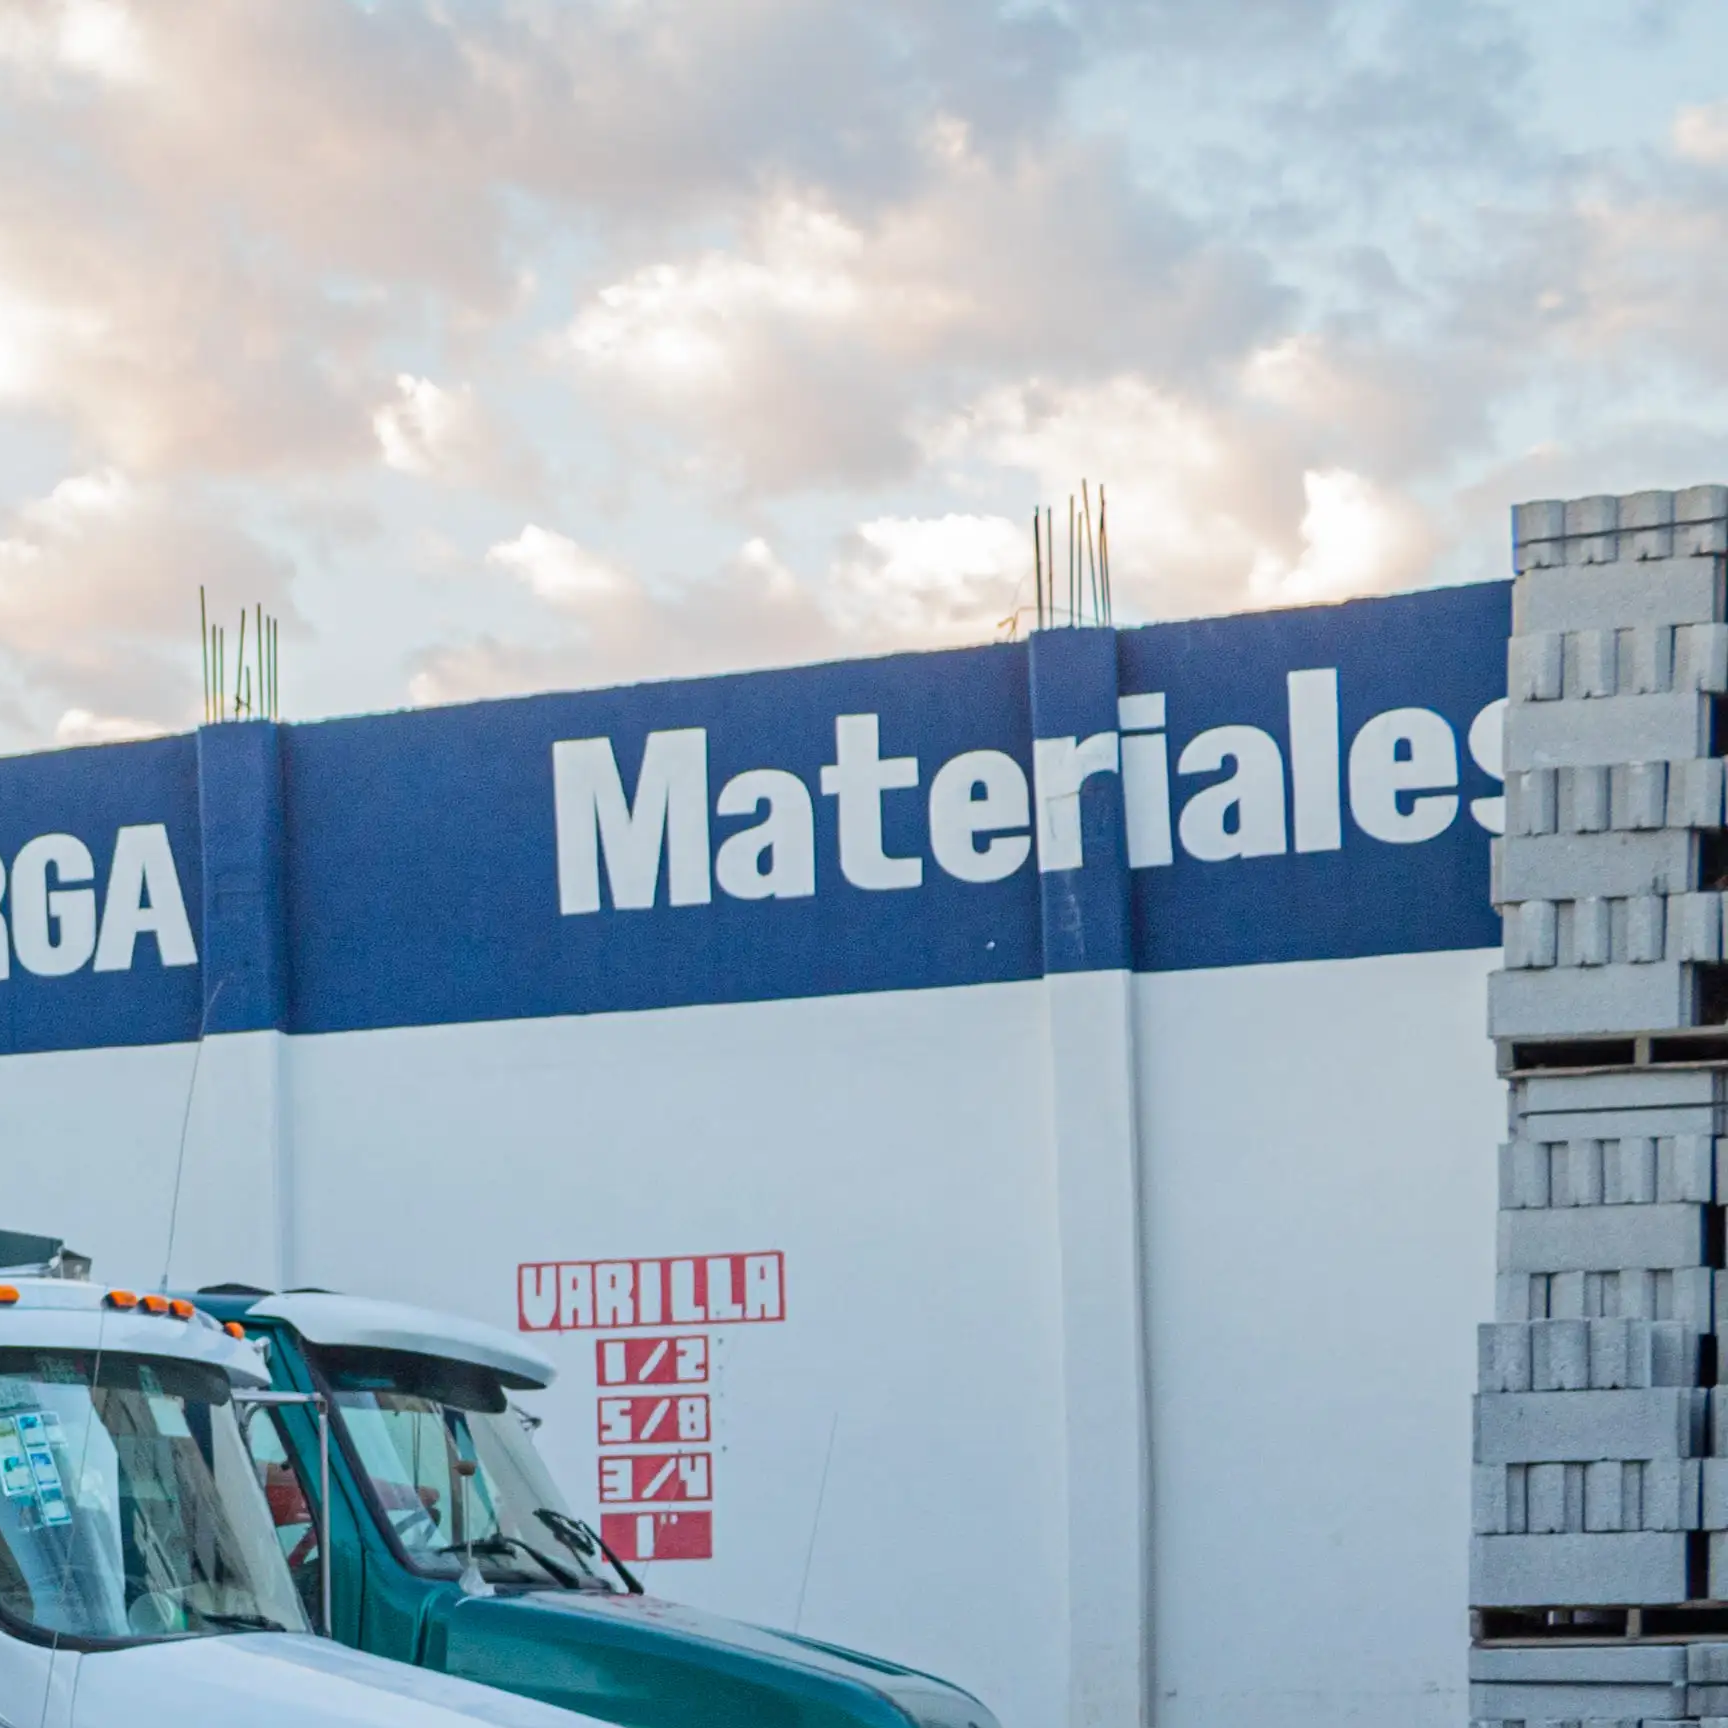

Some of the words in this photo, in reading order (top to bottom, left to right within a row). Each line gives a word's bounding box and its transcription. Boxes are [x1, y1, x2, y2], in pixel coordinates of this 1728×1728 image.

[521, 1254, 781, 1329] VARILLA
[603, 1337, 706, 1384] 1/2
[600, 1396, 708, 1443] 5/8
[602, 1454, 709, 1500] 3/4
